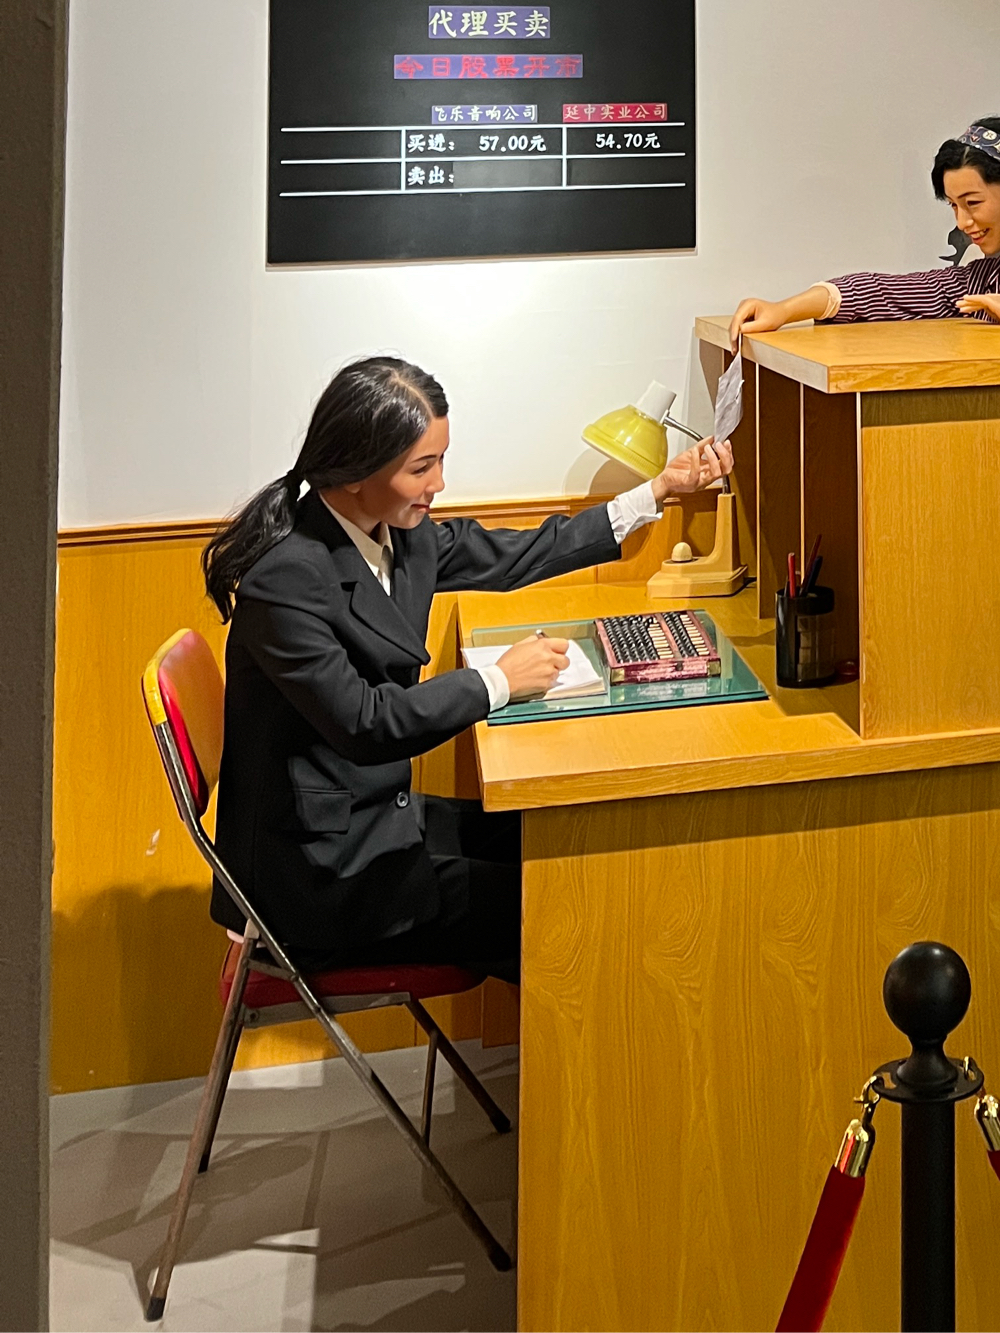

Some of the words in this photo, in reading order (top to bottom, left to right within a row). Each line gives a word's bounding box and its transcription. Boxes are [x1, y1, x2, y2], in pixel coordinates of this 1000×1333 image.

[429, 9, 549, 38] 代理买卖
[434, 104, 537, 122] 飞乐音响公司
[563, 104, 667, 120] 延中实业公司
[478, 135, 547, 153] 57.00元
[595, 132, 661, 150] 54.70元
